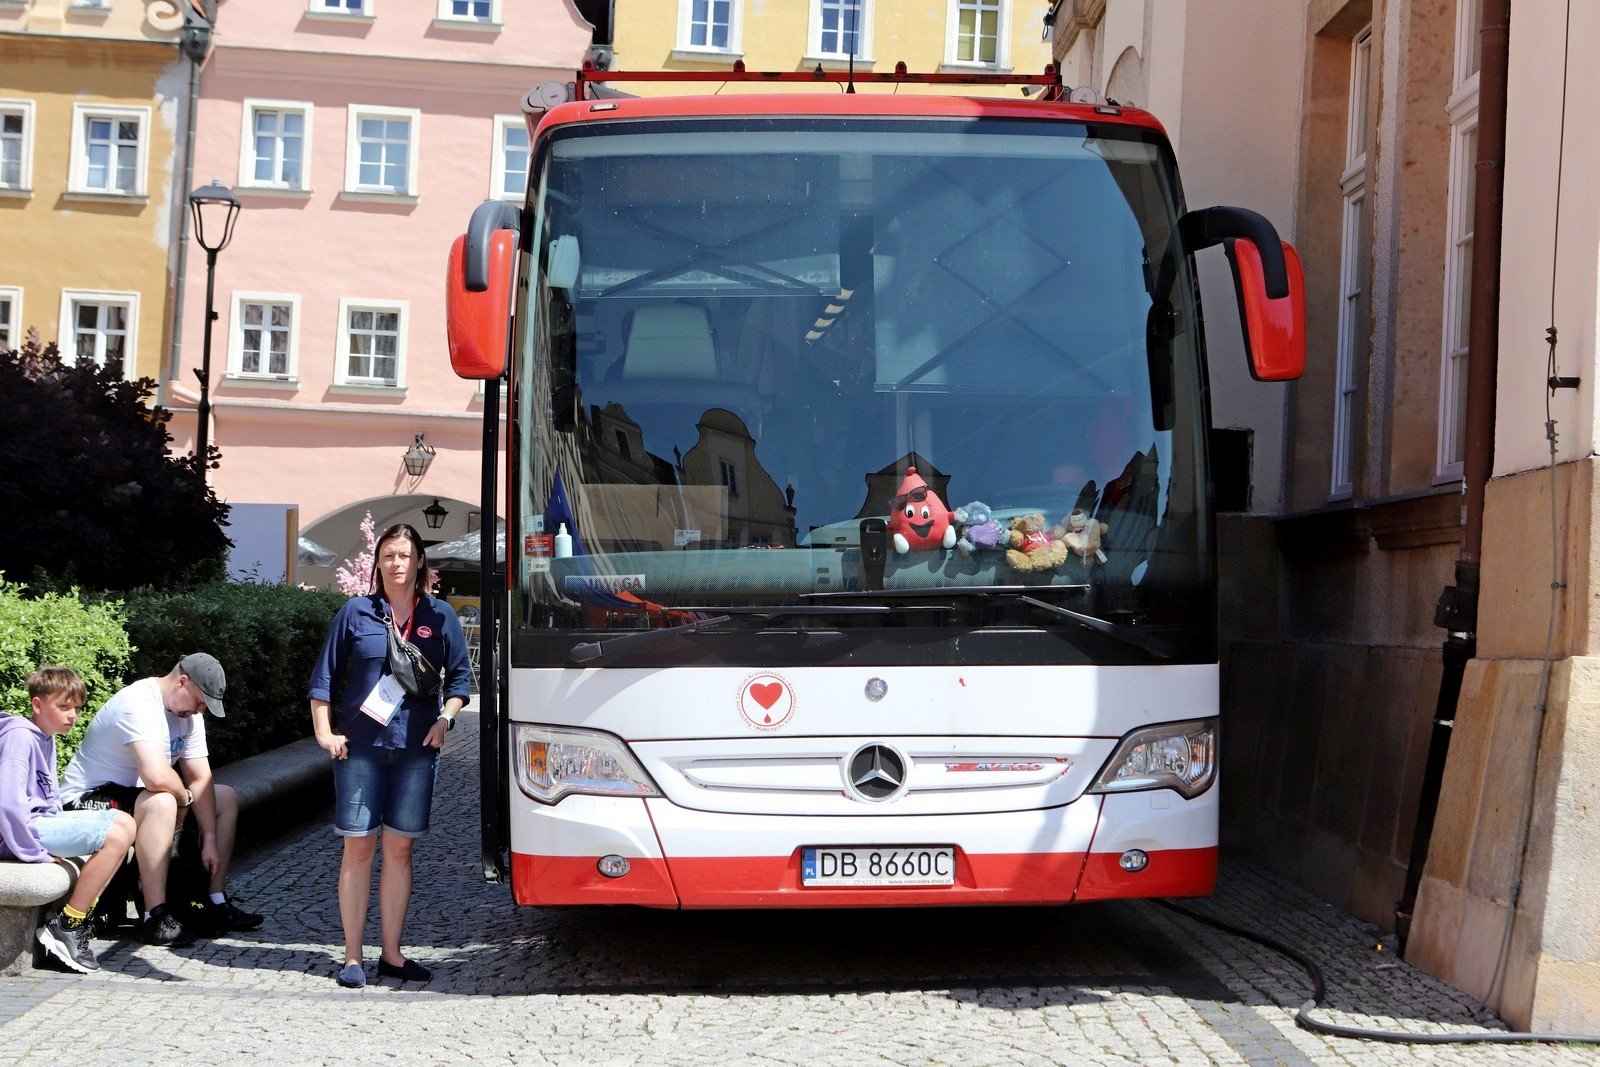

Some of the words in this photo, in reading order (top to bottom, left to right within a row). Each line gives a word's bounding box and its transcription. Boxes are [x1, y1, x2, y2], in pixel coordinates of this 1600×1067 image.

[805, 868, 815, 876] PL
[821, 852, 858, 877] DB
[869, 852, 949, 876] 8660C
